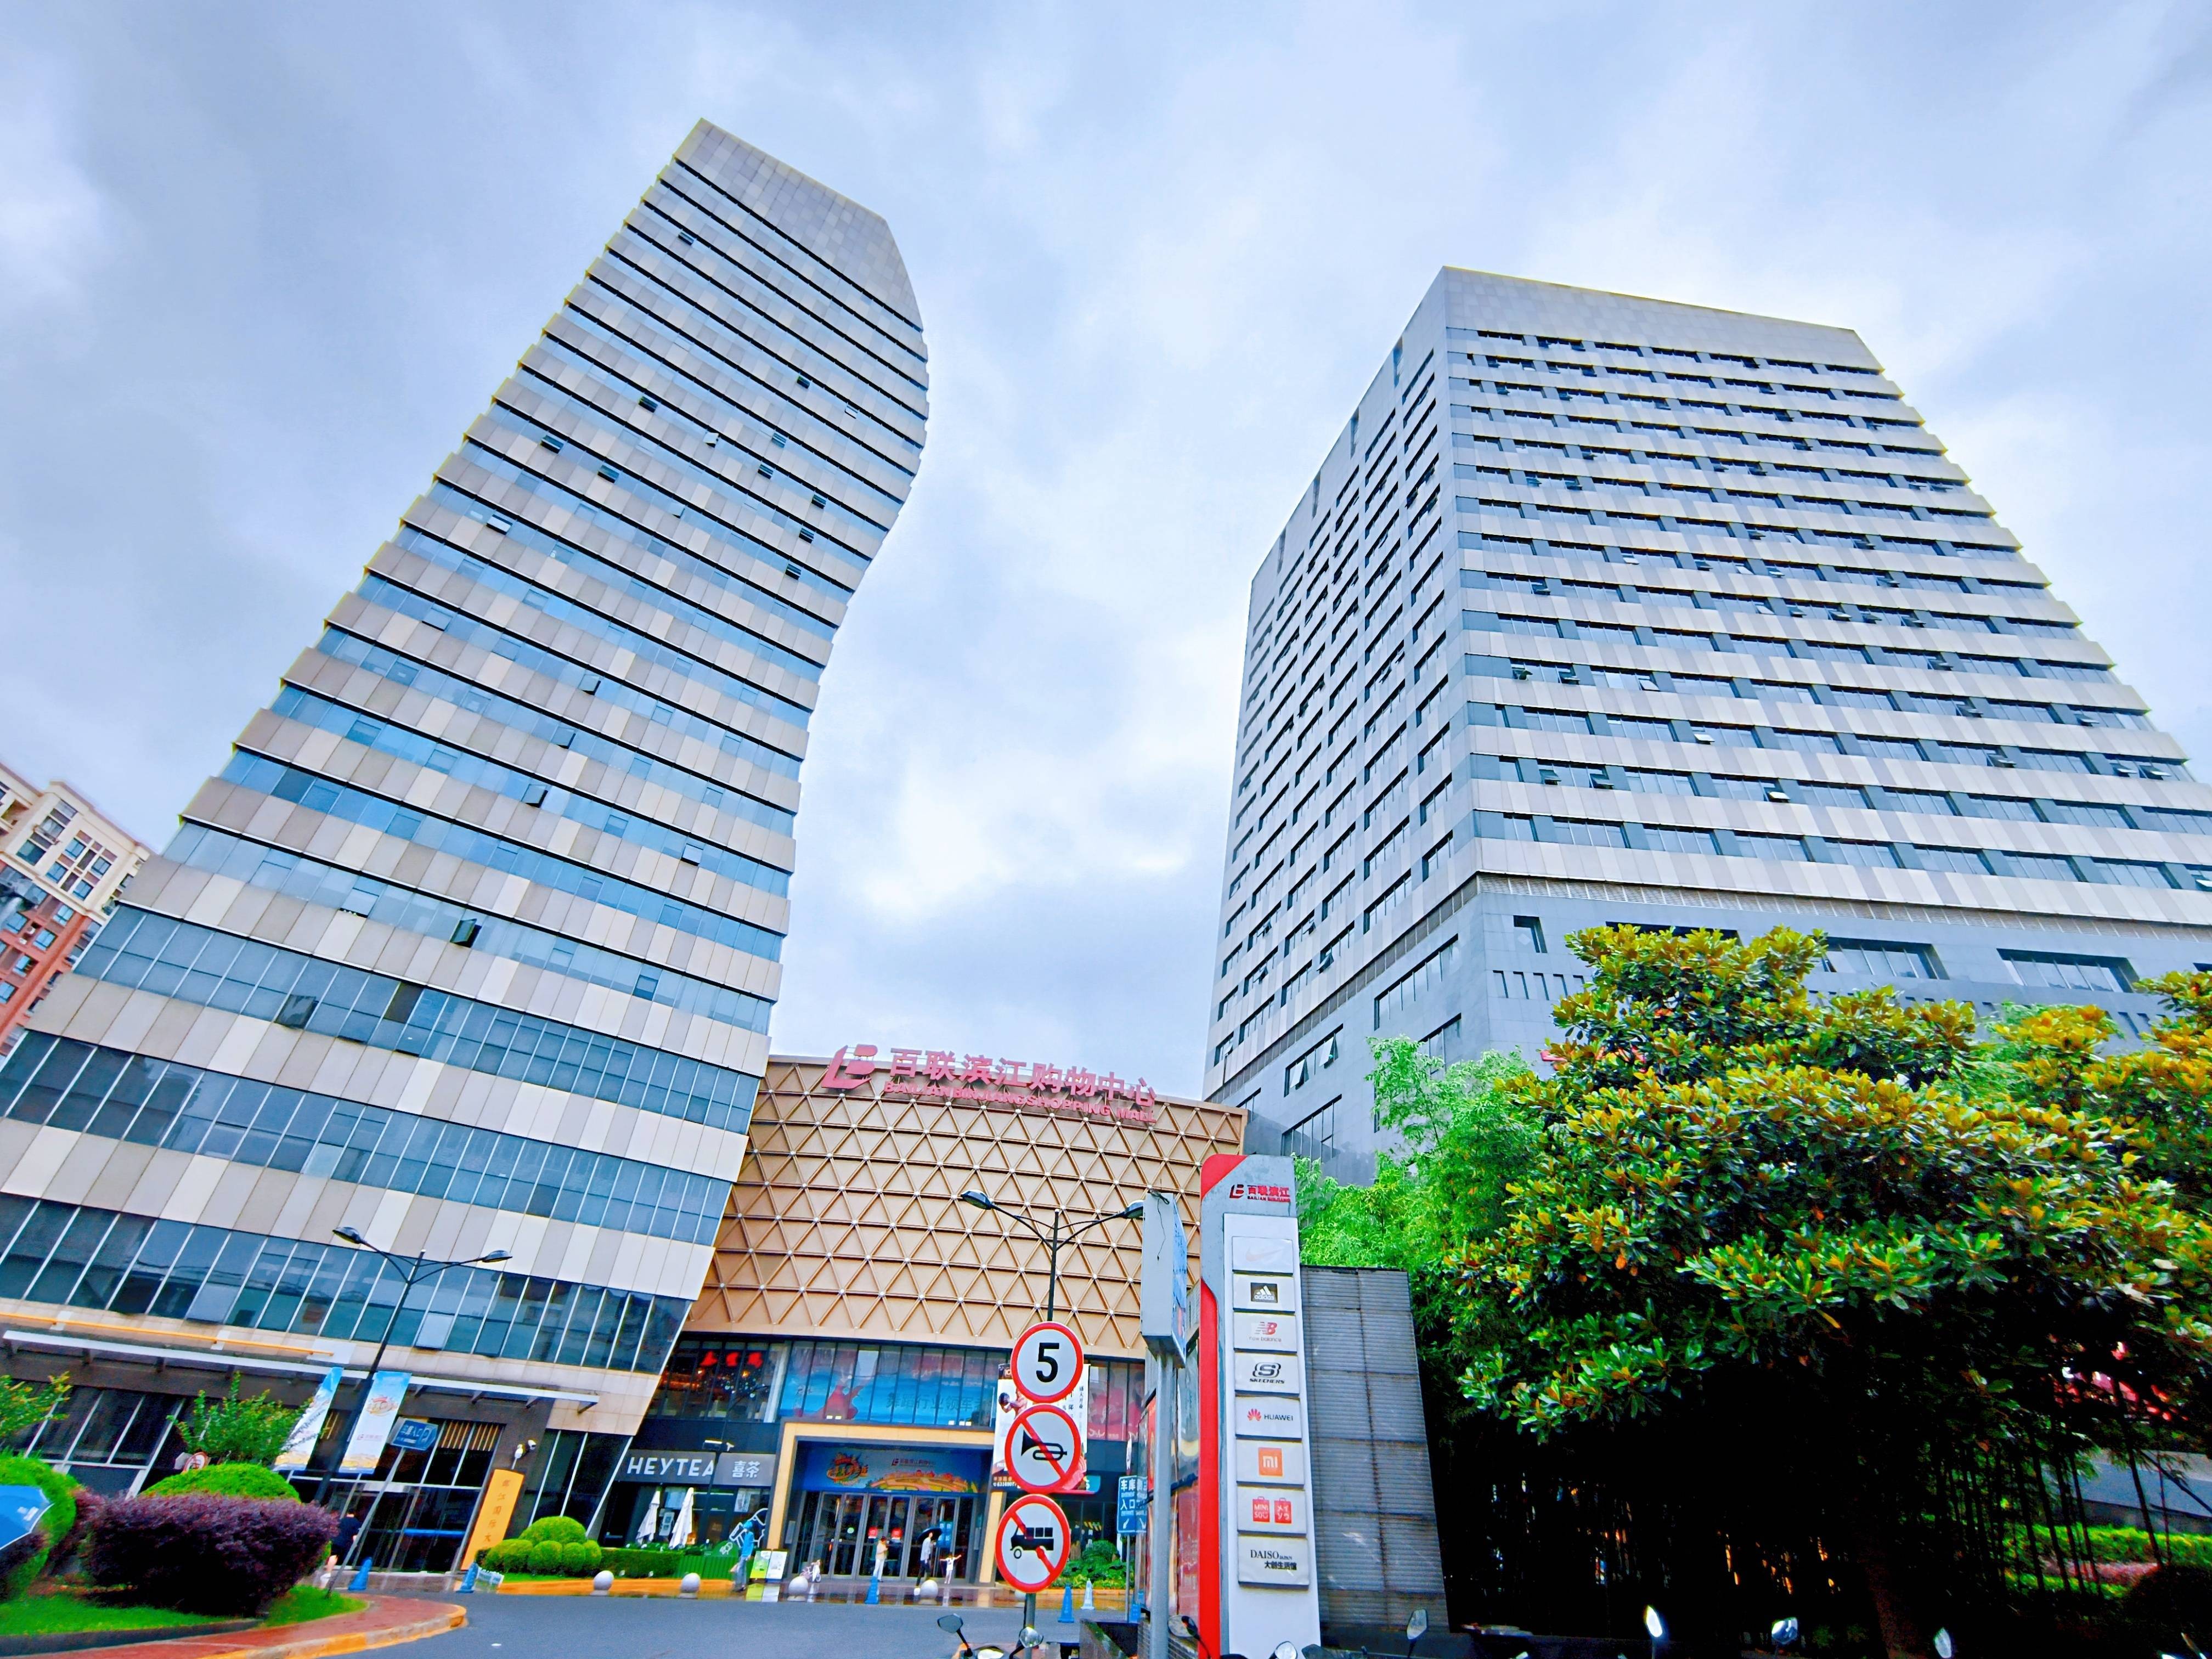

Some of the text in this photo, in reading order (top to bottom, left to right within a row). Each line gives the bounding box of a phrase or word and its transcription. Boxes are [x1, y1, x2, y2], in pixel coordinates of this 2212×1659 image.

[890, 1047, 1157, 1107] 百联滨江购物中心
[884, 1081, 950, 1097] BAILIAN
[1116, 1107, 1157, 1123] MALL
[1036, 1342, 1060, 1383] 5
[627, 1457, 714, 1477] HEYTEA
[732, 1460, 760, 1478] 喜茶
[1120, 1499, 1135, 1510] 入口
[1250, 1549, 1279, 1559] DAISO
